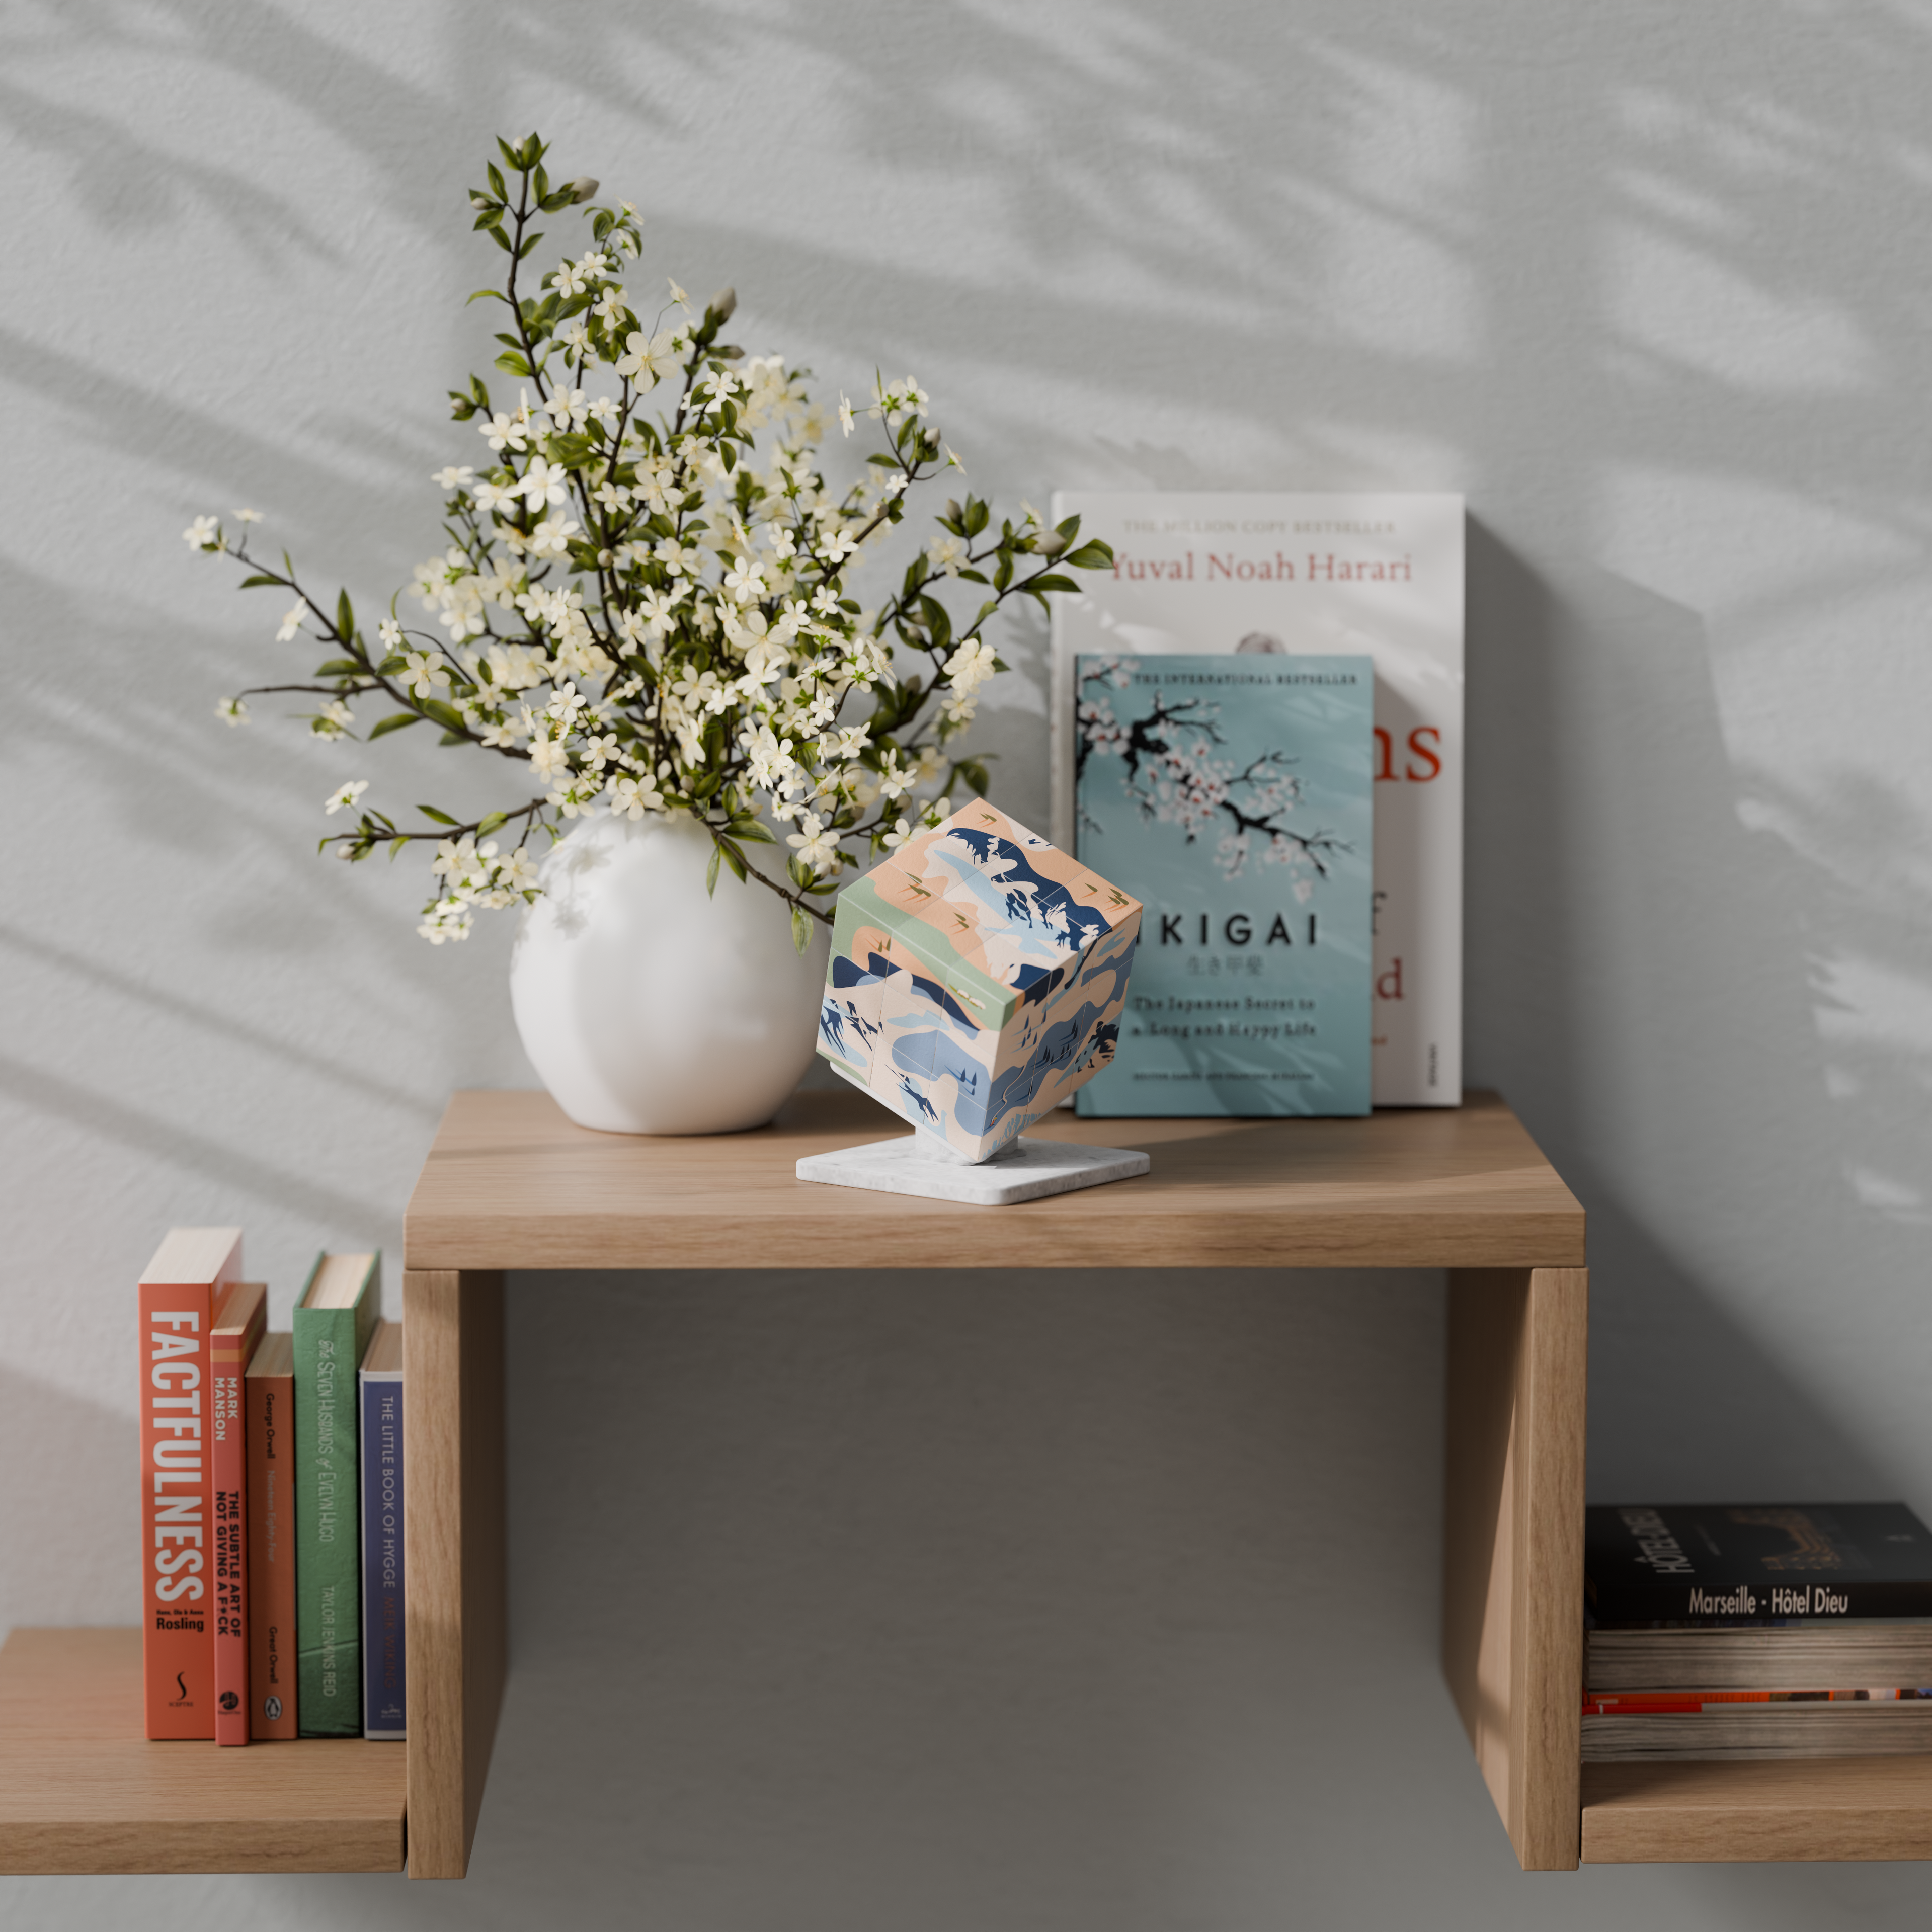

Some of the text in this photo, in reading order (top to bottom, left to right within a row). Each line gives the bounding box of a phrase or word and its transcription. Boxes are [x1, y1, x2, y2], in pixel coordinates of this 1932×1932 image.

[1112, 551, 1412, 581] Yuval Noah Harari
[1134, 996, 1316, 1015] The Japanese Secret to
[1150, 1022, 1189, 1039] Long
[1194, 1023, 1224, 1036] and
[1229, 1023, 1279, 1040] Happy
[1284, 1022, 1316, 1036] Life
[215, 1377, 225, 1441] MANSON
[227, 1377, 238, 1419] MARK
[382, 1396, 393, 1421] THE
[265, 1393, 276, 1459] George Orwell
[316, 1339, 337, 1542] The SEVEN HUSBANDS of EVELYN HUGO
[382, 1426, 394, 1464] LITTLE
[151, 1311, 204, 1602] FACTFULNESS
[216, 1492, 226, 1521] NOT
[382, 1469, 395, 1511] BOOK
[266, 1470, 277, 1562] Nineteen Eighty-Four
[383, 1515, 395, 1535] OF
[217, 1526, 227, 1577] GIVING
[229, 1491, 241, 1637] THE SUBTLE ART OF
[383, 1539, 396, 1588] HYGGE
[218, 1582, 228, 1592] A
[1689, 1585, 1756, 1614] Marseille
[1772, 1585, 1810, 1614] Hôtel
[1814, 1586, 1848, 1614] Dieu
[156, 1618, 204, 1632] Rosling
[384, 1596, 396, 1630] MEIK
[269, 1626, 278, 1683] Great Orwell
[322, 1586, 336, 1697] TAYLOR JENKINS REID
[384, 1634, 397, 1689] WIKING
